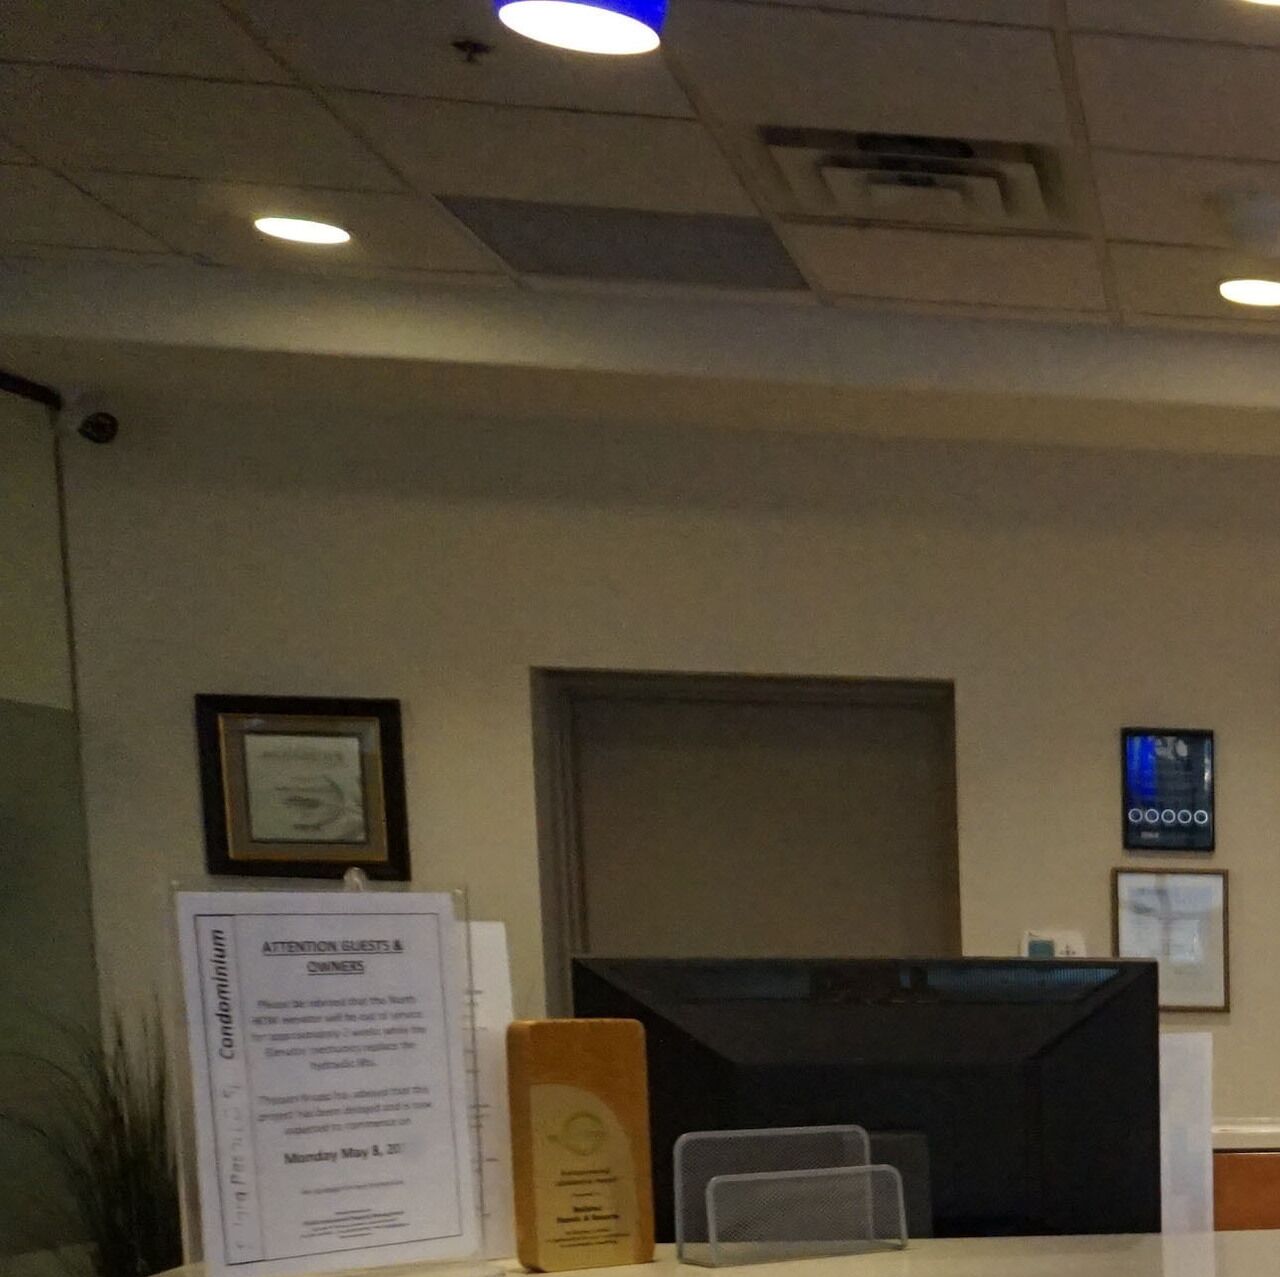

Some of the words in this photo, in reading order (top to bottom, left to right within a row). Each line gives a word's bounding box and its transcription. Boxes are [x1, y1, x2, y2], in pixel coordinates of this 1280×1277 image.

[263, 940, 337, 953] ATTENTION
[341, 939, 389, 952] GUESTS
[393, 939, 403, 951] &
[307, 960, 364, 973] OWNERS
[210, 929, 234, 1060] Condominium
[284, 1151, 337, 1163] Monday
[340, 1148, 369, 1159] May
